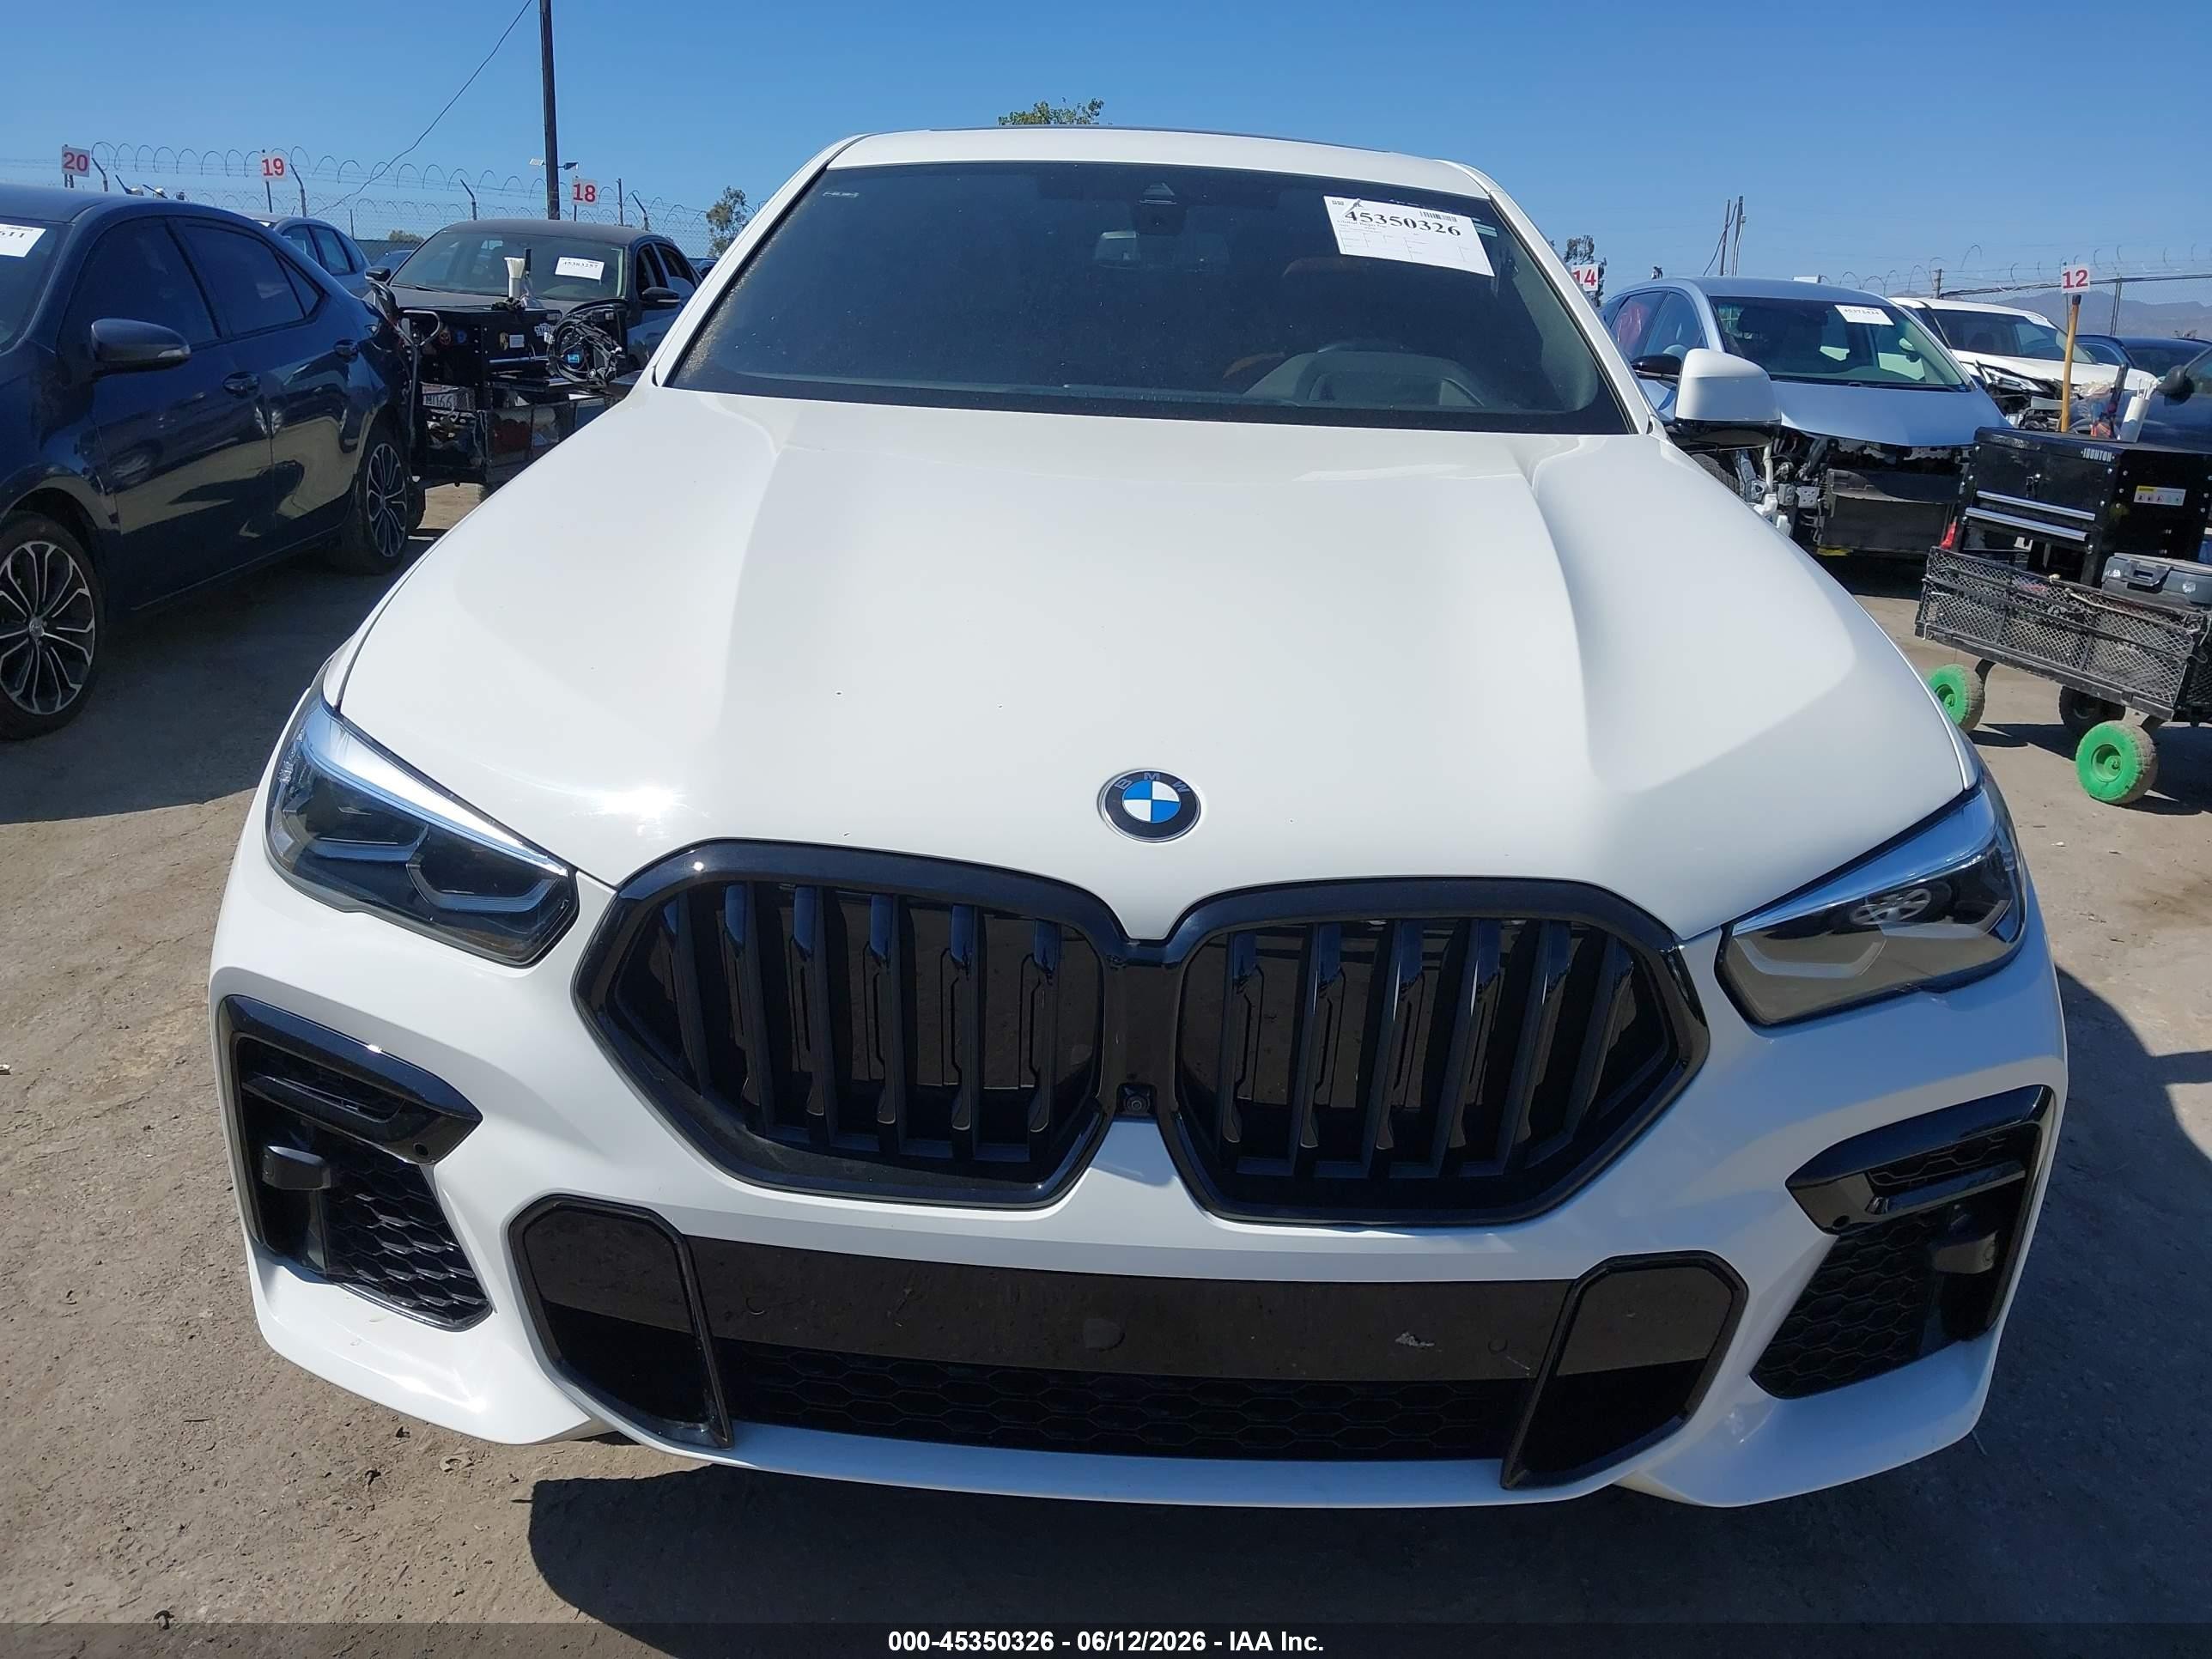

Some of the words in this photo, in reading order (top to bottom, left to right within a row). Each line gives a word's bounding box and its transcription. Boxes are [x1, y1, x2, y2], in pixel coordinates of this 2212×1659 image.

[63, 151, 88, 172] 20
[262, 157, 284, 176] 19
[573, 183, 596, 203] 18
[1345, 211, 1462, 236] 45350326
[2063, 269, 2088, 289] 12
[1114, 772, 1191, 793] BMW
